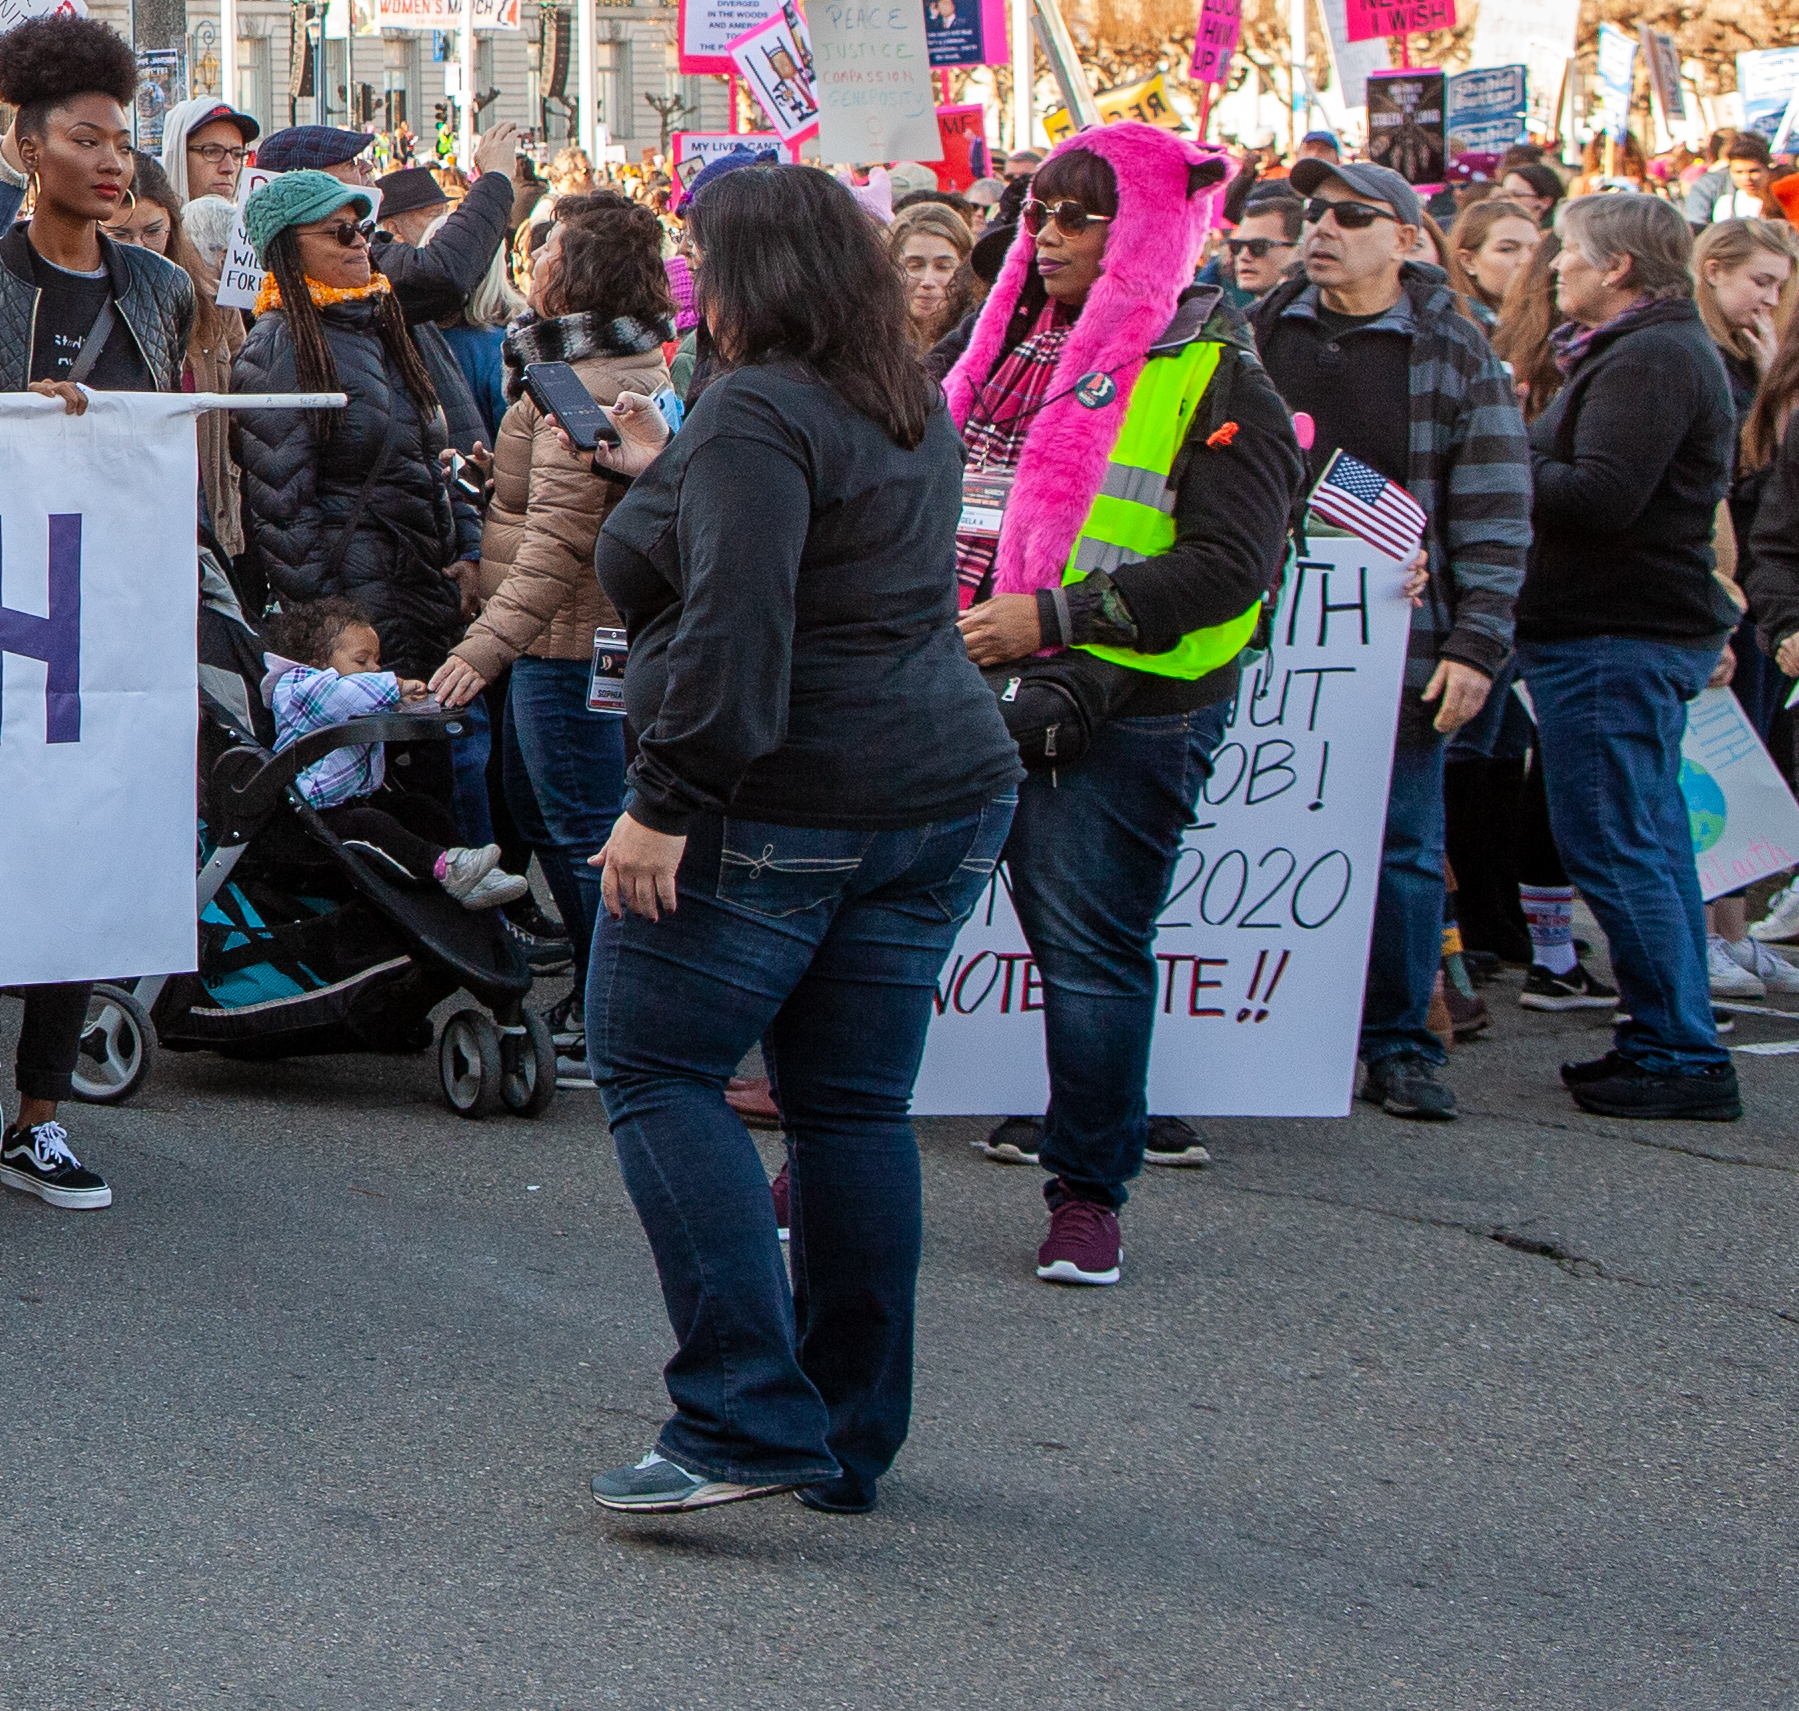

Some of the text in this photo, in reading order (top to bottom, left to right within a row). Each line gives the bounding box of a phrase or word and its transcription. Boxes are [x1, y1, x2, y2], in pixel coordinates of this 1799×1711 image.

[737, 11, 769, 19] WOODS
[825, 4, 908, 30] PEACE
[1371, 1, 1447, 34] I WISH
[700, 43, 715, 51] THE
[822, 43, 914, 61] JUSTICE
[822, 70, 915, 85] COMPASSION
[692, 142, 710, 151] MY
[1286, 561, 1369, 647] TH
[1155, 846, 1353, 930] 2020
